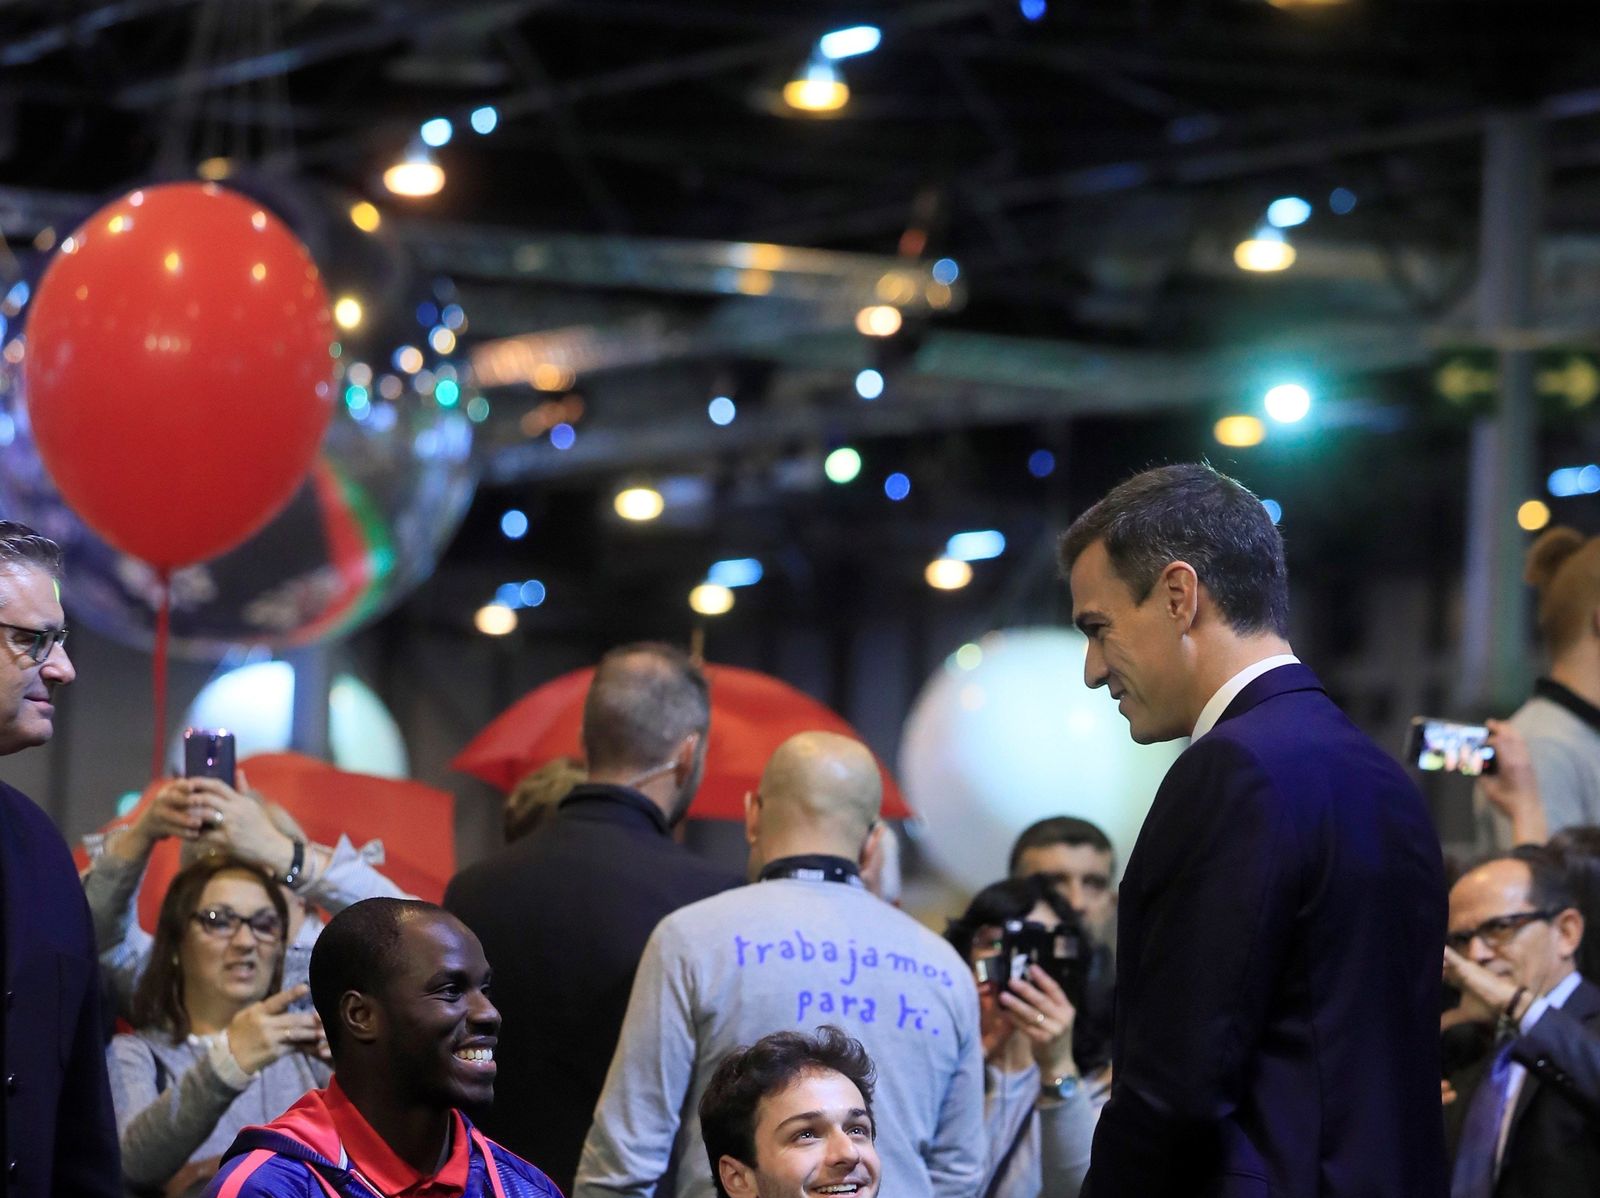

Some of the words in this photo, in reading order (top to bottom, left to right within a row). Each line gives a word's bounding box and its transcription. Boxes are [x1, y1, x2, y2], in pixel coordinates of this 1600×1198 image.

[734, 929, 954, 988] trabajamos
[797, 990, 876, 1023] para
[897, 993, 939, 1036] ti.
